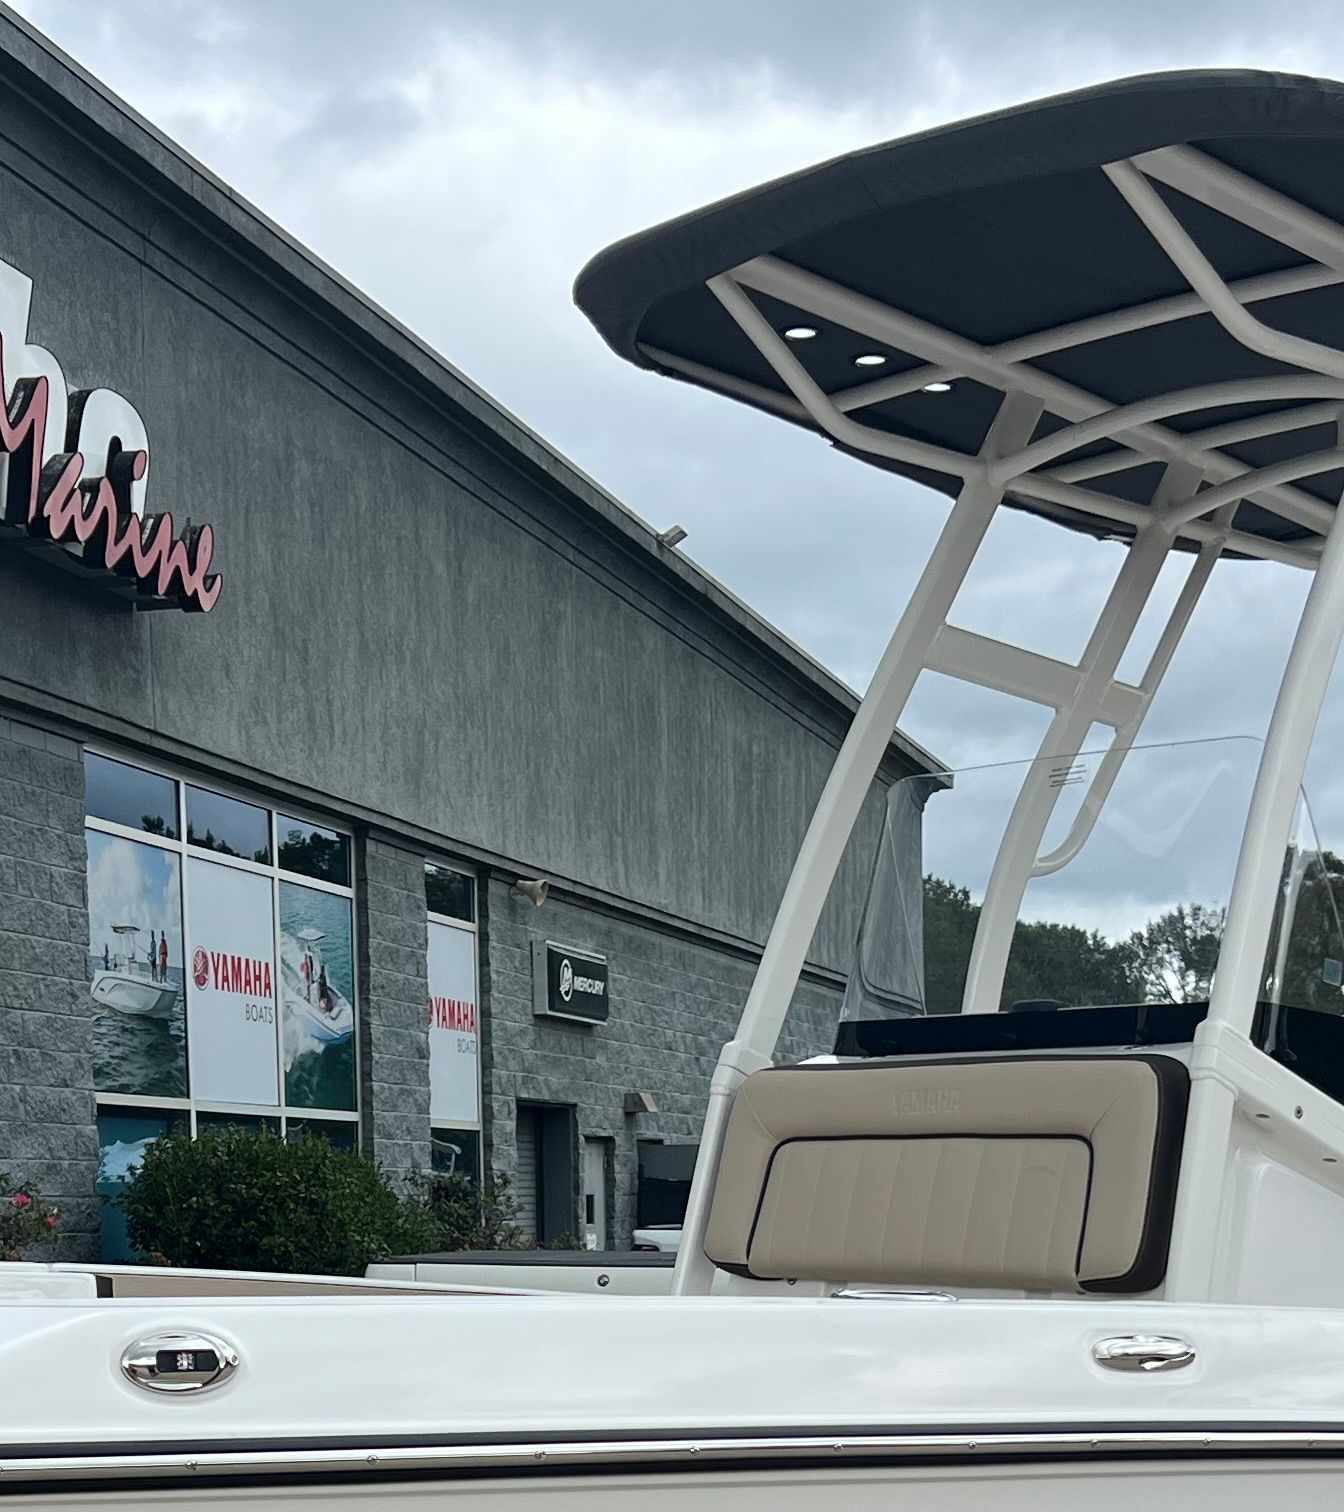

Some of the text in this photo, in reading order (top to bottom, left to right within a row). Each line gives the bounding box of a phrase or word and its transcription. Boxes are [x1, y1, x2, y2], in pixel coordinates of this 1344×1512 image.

[210, 950, 273, 999] YAMAHA
[573, 975, 605, 996] MERCURY
[244, 1003, 274, 1025] BOATS
[434, 996, 477, 1034] YAMAHA
